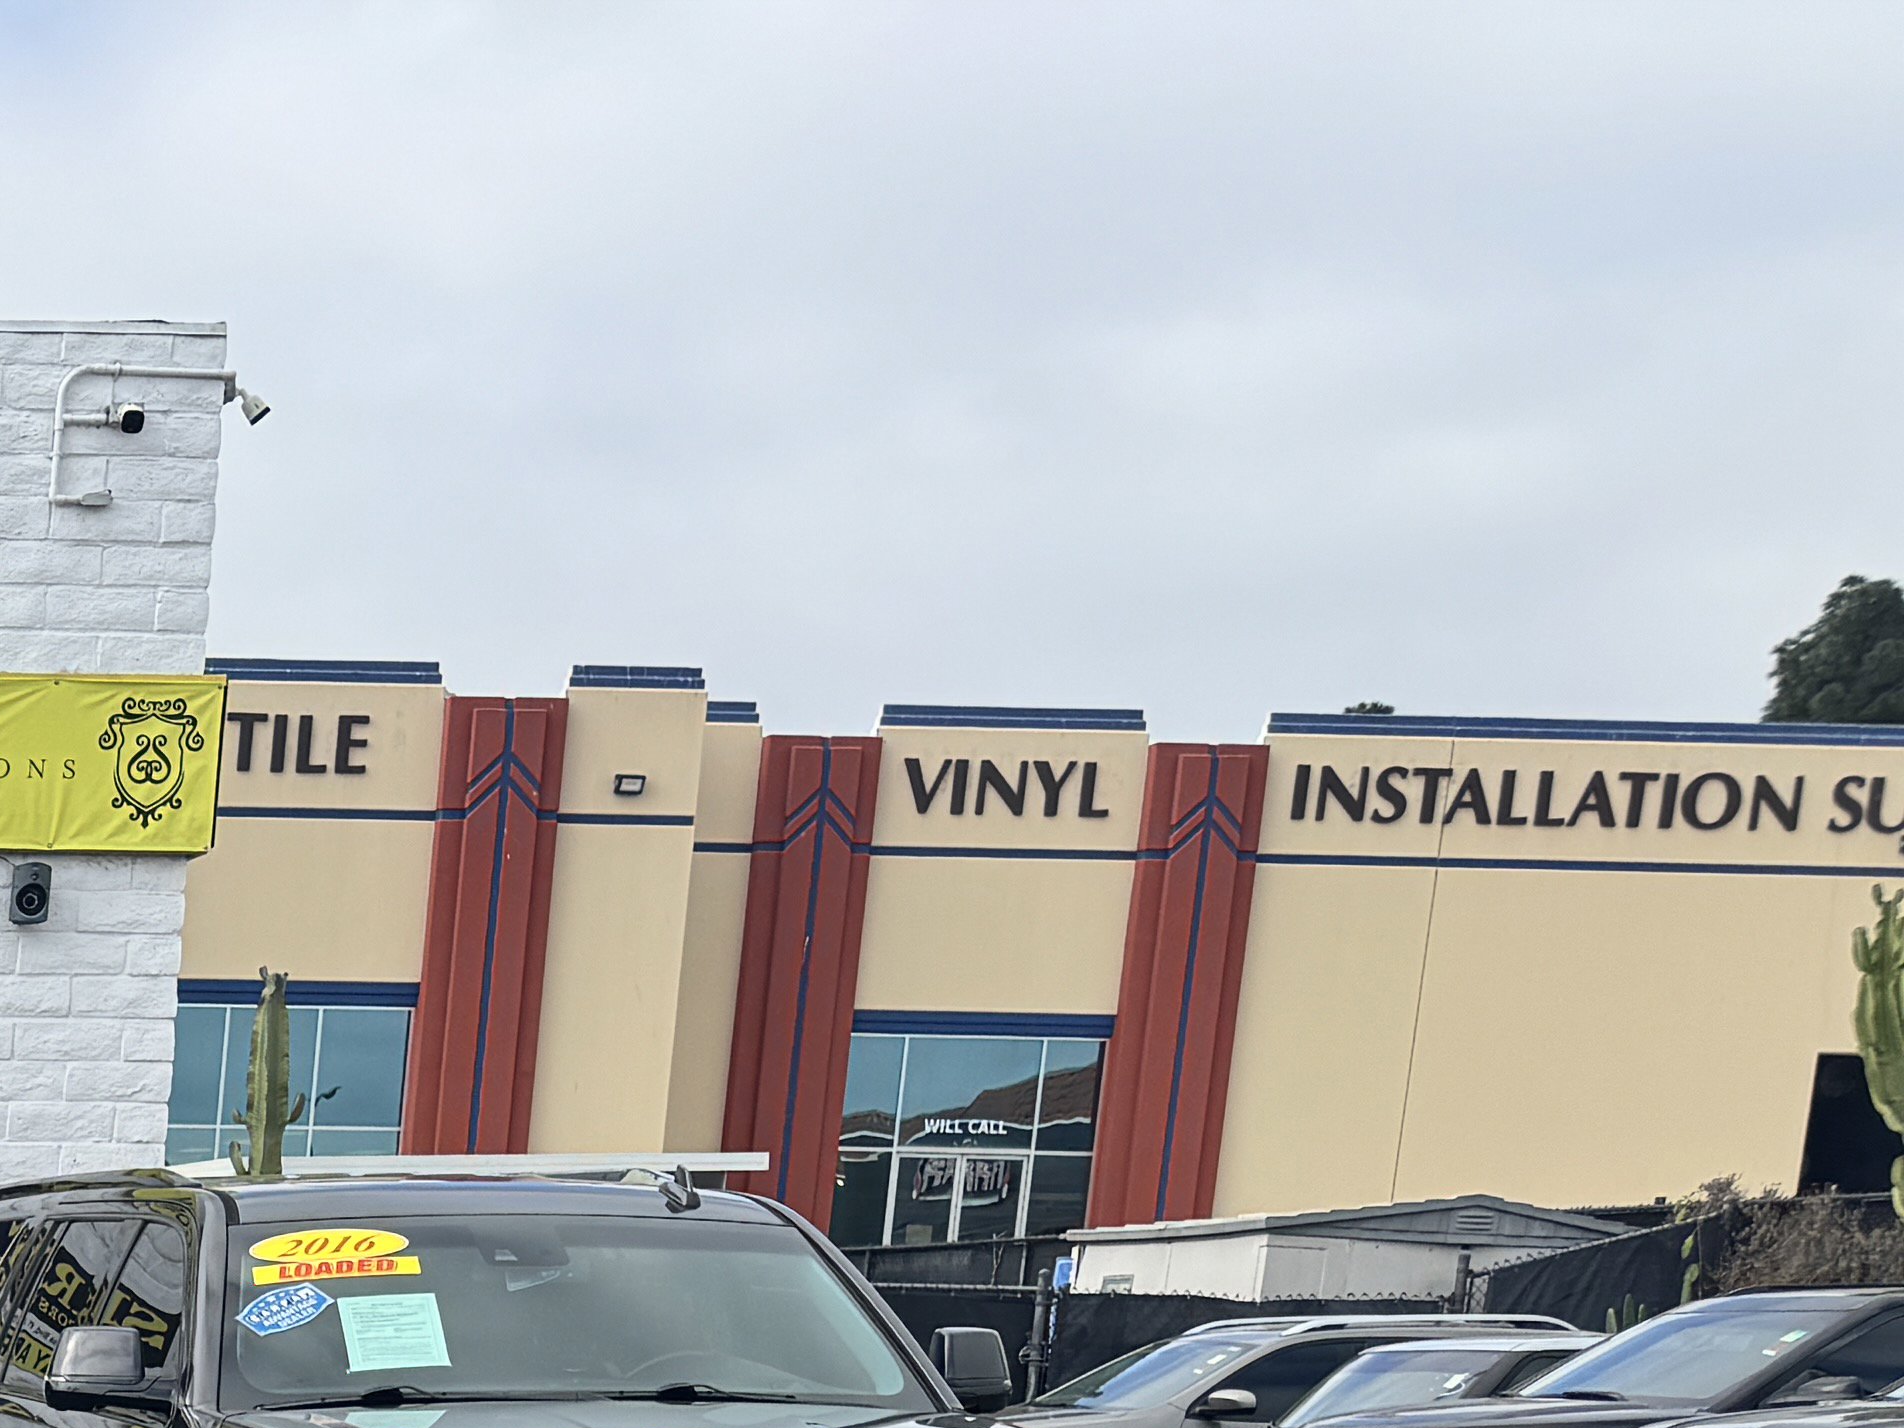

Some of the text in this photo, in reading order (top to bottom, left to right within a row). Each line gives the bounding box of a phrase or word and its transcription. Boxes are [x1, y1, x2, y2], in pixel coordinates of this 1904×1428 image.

[227, 712, 371, 775] TILE
[904, 757, 1110, 819] VINYL
[1289, 764, 1805, 832] INSTALLATION
[924, 1118, 1008, 1135] WILL CALL
[278, 1235, 382, 1258] 2016
[279, 1258, 398, 1279] LOADED
